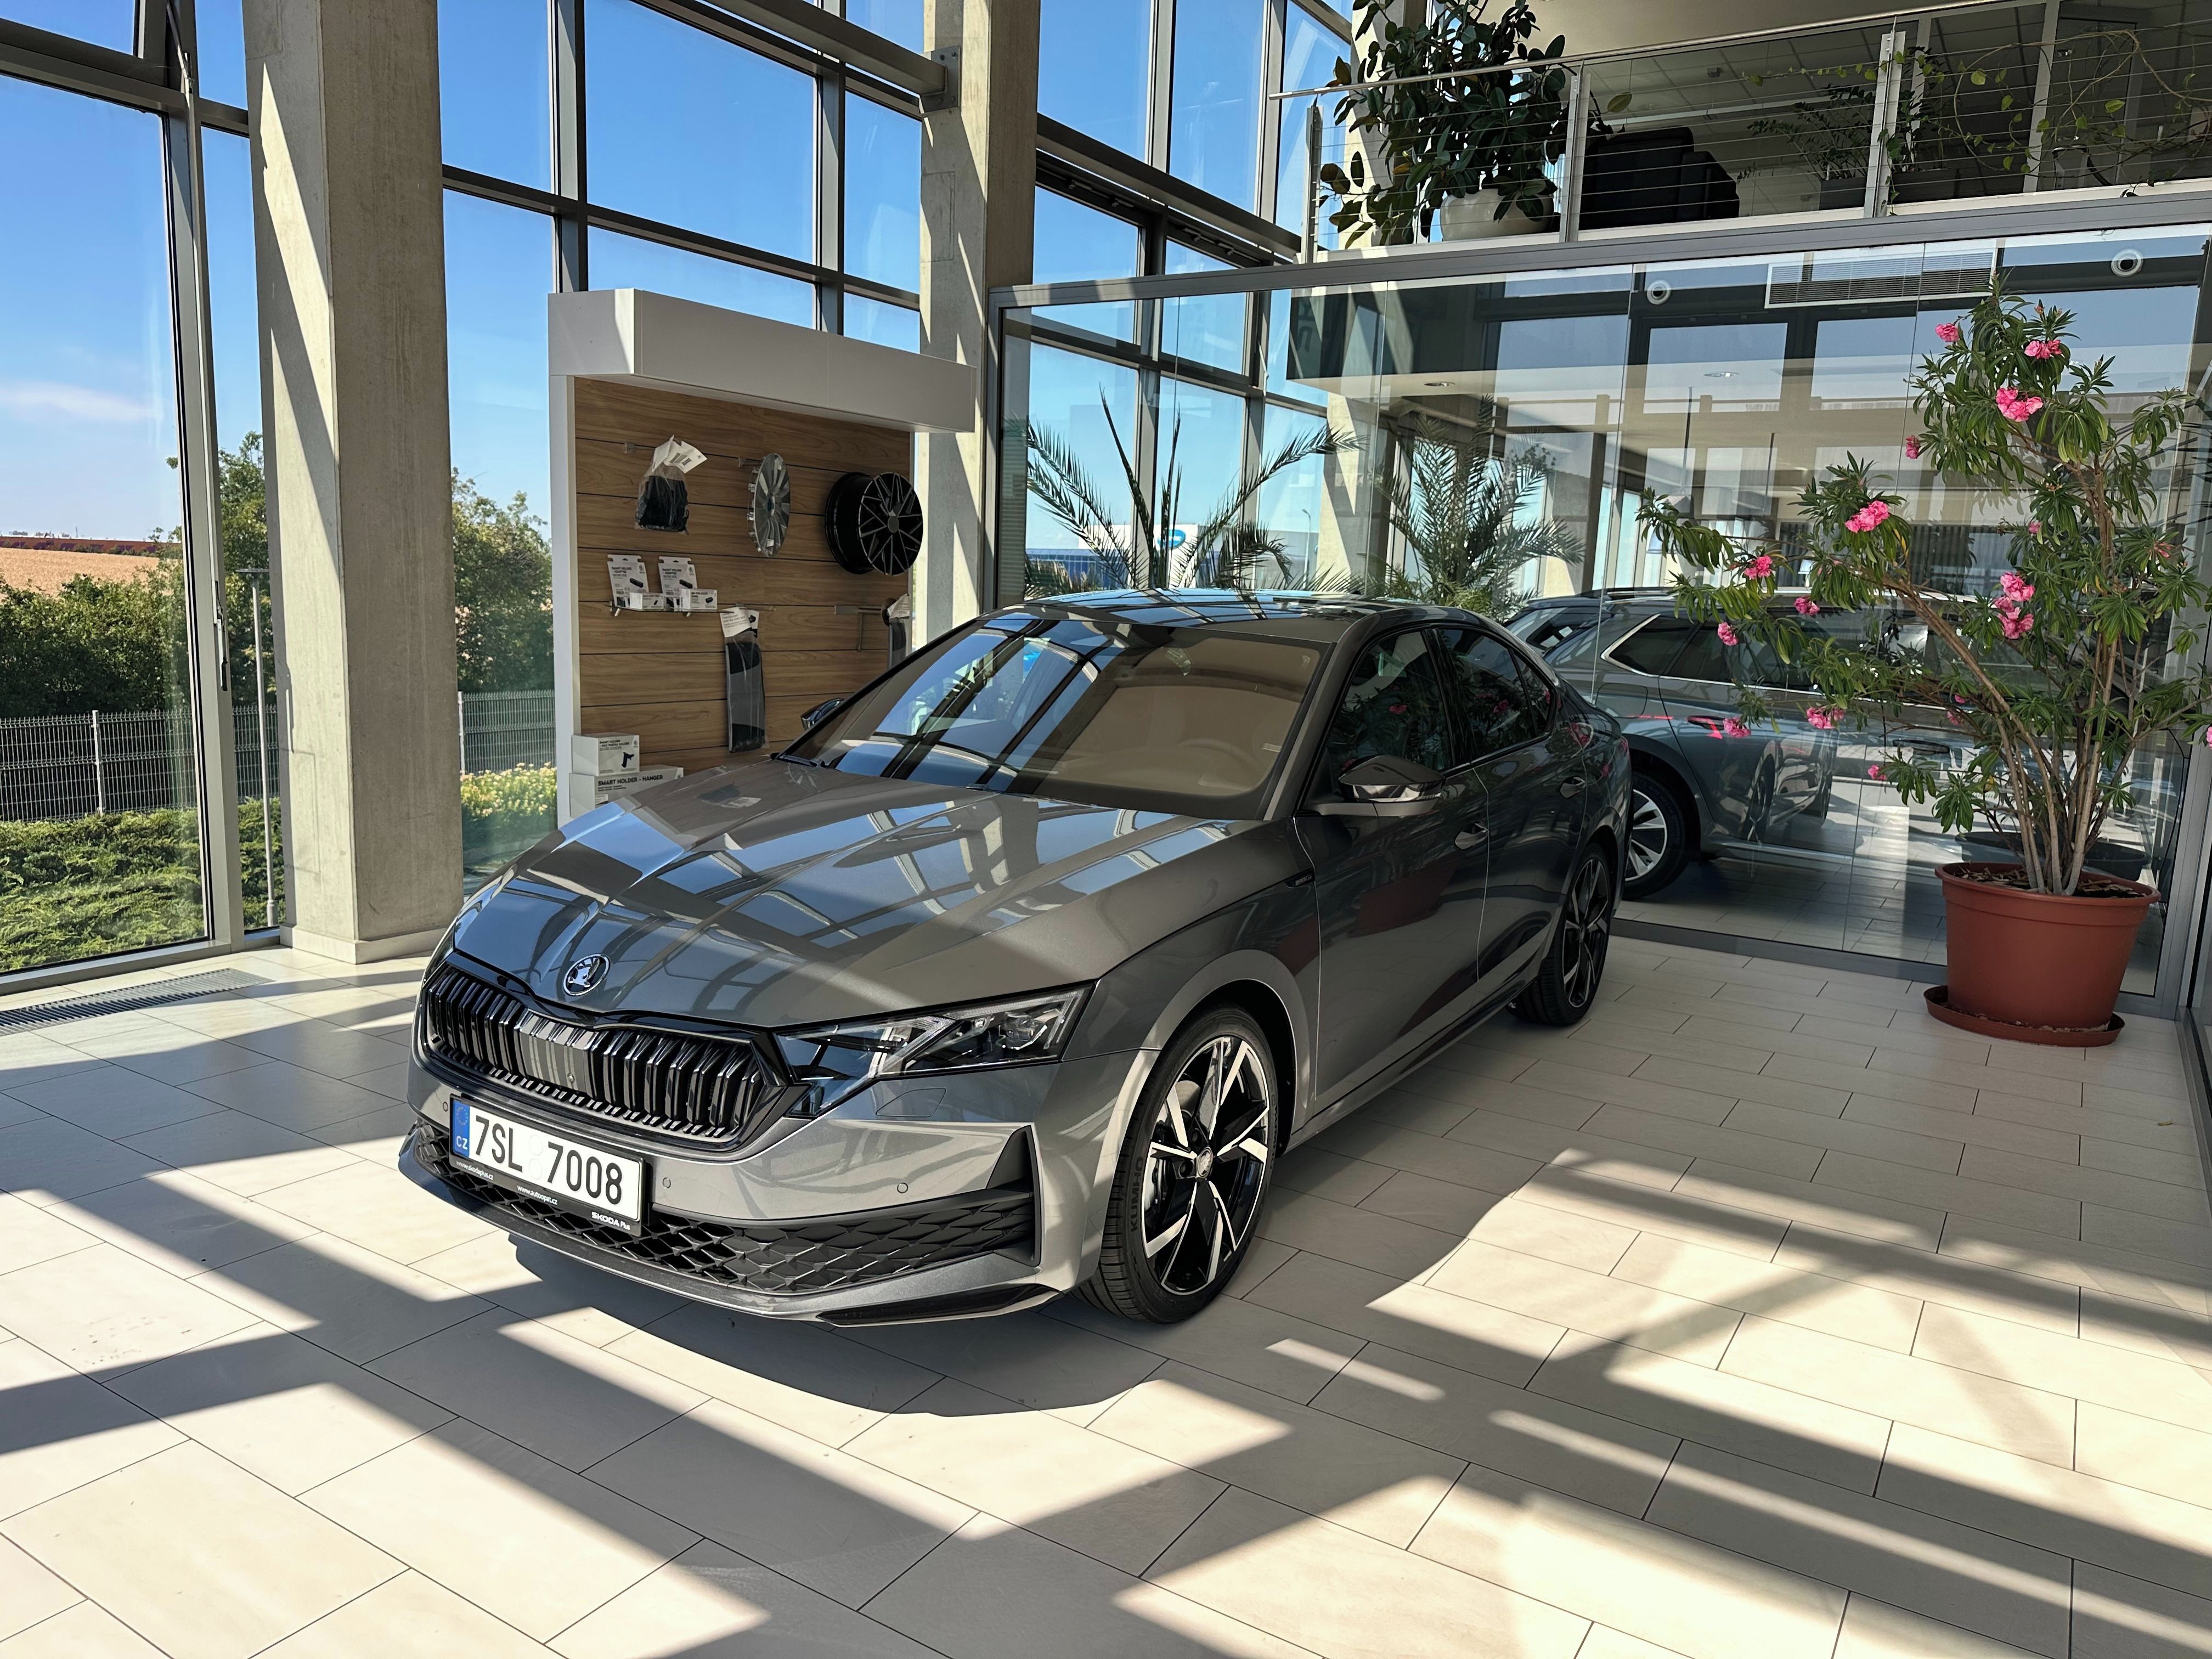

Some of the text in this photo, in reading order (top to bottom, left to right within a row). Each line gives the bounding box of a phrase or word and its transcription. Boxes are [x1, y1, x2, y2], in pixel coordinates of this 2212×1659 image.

[456, 1136, 468, 1150] CZ
[456, 1160, 494, 1180] www.skodaplus.cz
[476, 1115, 623, 1205] 7SL 7008
[517, 1185, 558, 1205] www.autoopat.cz
[1131, 1156, 1143, 1233] KUMHO
